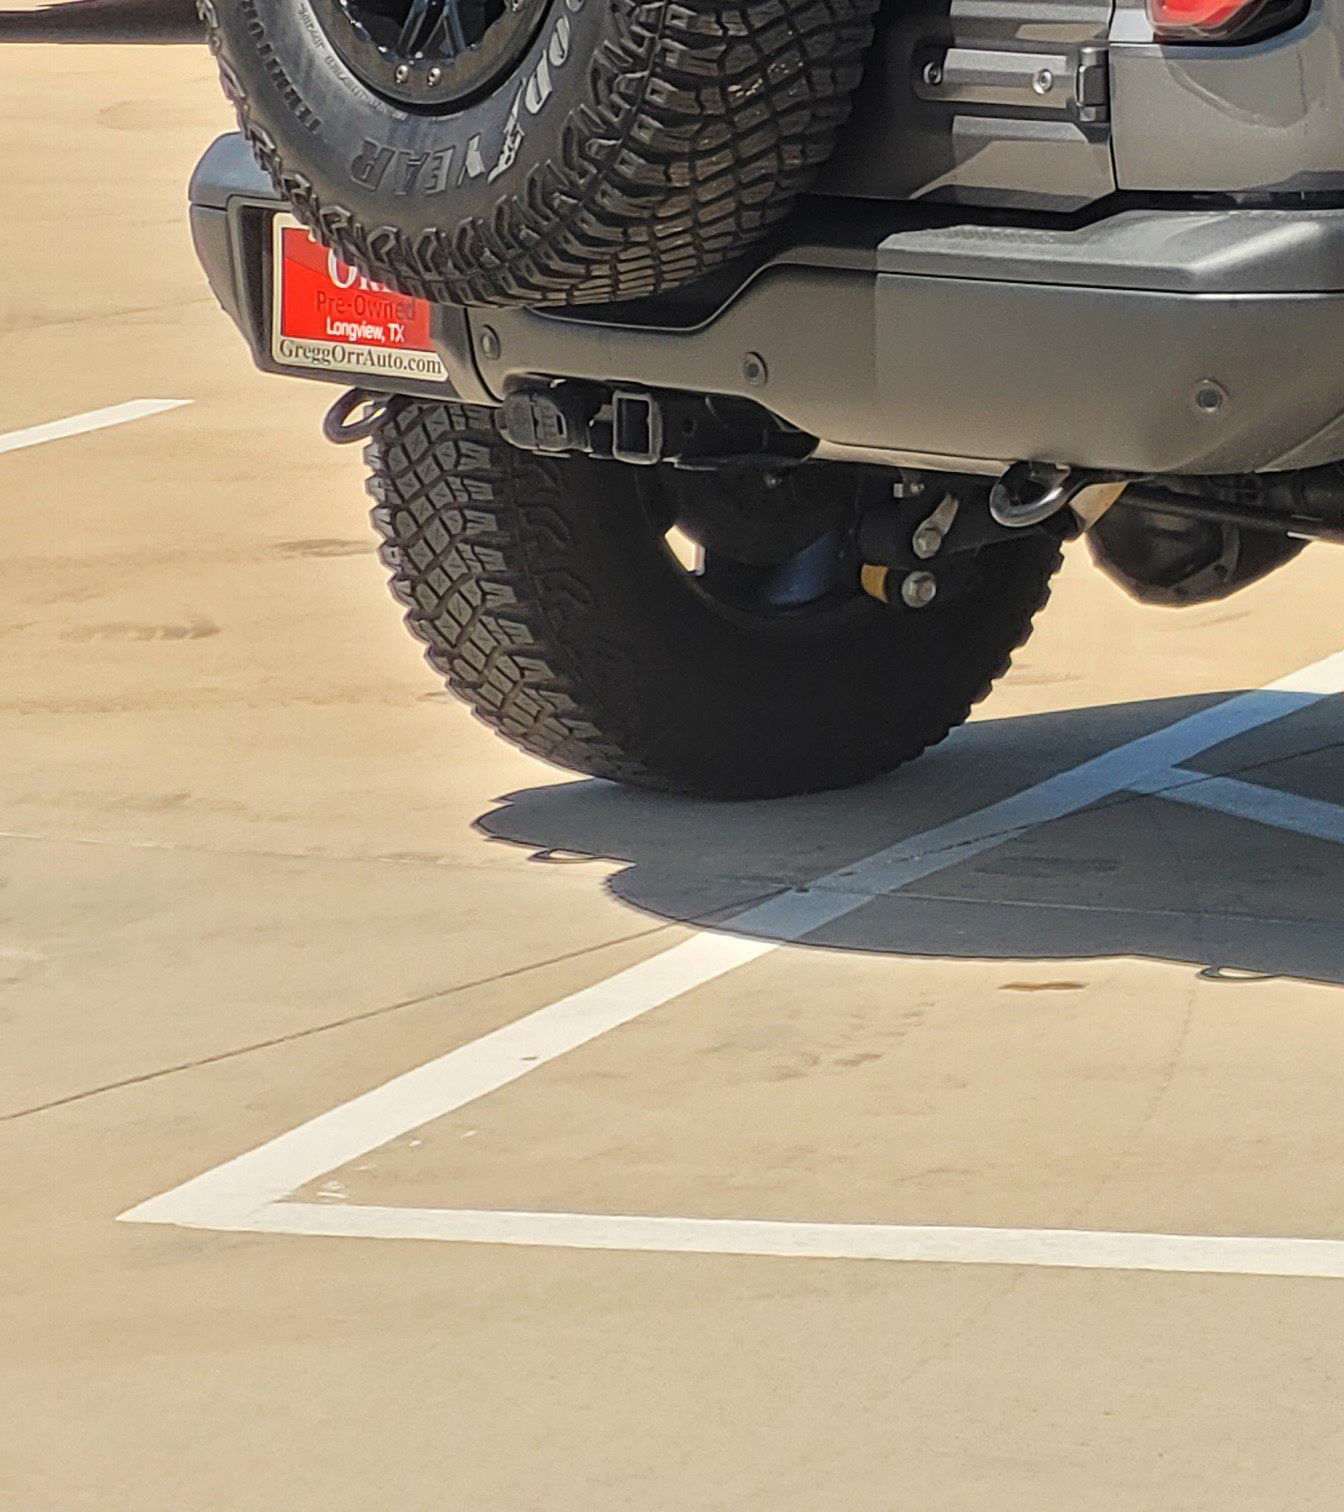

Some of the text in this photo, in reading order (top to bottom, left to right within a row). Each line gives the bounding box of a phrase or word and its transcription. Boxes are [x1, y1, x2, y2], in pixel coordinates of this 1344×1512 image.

[316, 290, 416, 321] Pre-Owned
[326, 316, 405, 343] Longview, TX
[280, 339, 442, 375] GreggOrrAuto.com
